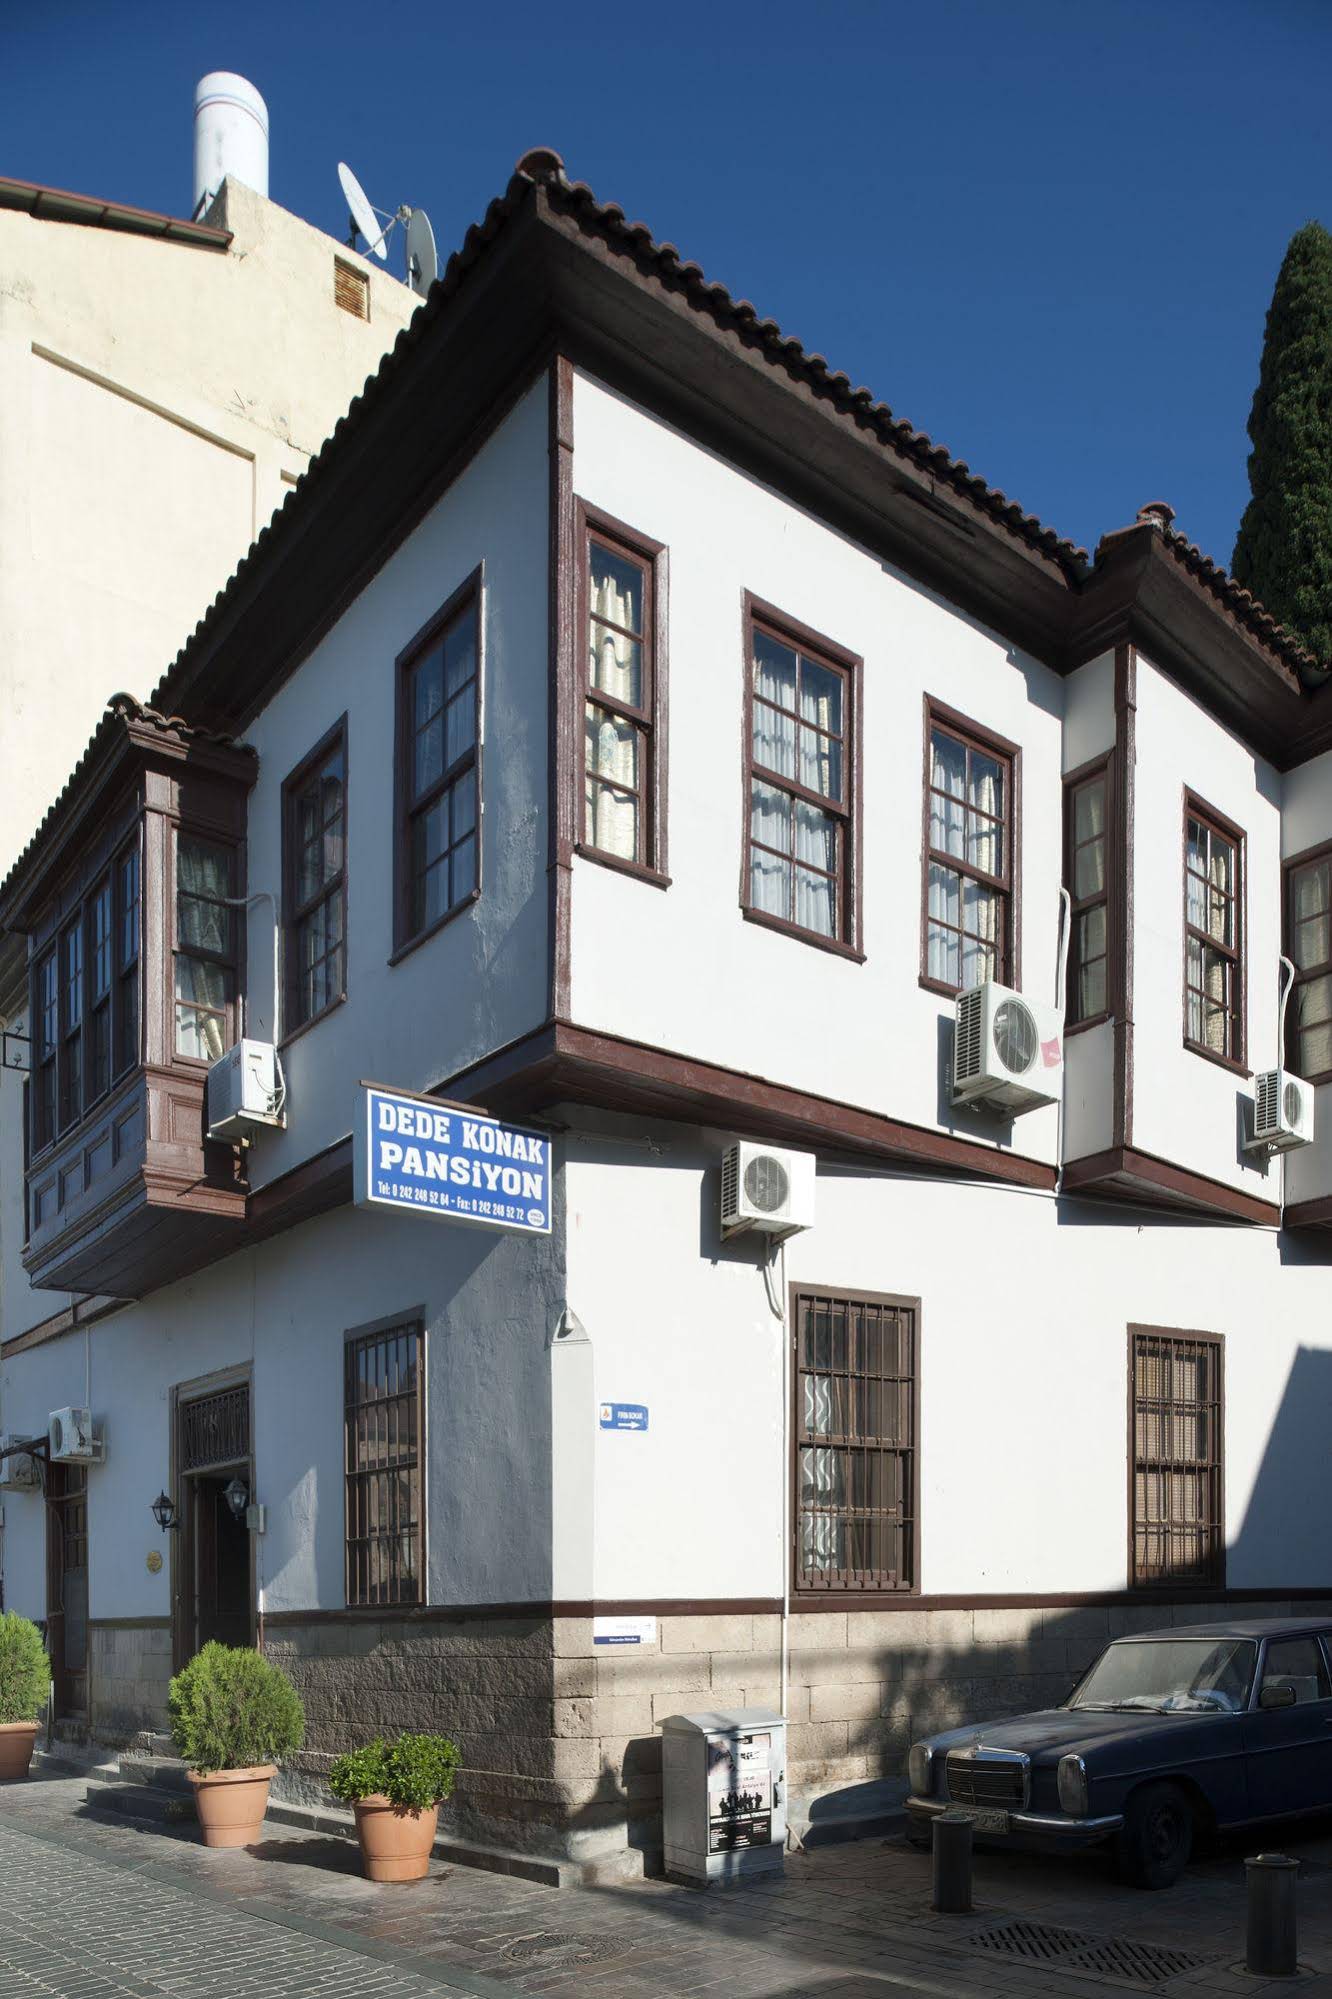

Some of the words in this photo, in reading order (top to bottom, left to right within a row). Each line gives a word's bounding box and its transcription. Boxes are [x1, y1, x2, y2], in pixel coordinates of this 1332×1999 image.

[378, 1102, 450, 1144] DEDE
[462, 1121, 544, 1164] KONAK
[378, 1181, 390, 1195] Tel:
[392, 1184, 398, 1197] 0
[400, 1185, 413, 1199] 242
[430, 1190, 439, 1205] 52
[457, 1196, 470, 1210] Fax:
[472, 1199, 477, 1212] 0
[479, 1200, 491, 1214] 242
[506, 1205, 515, 1219] 52
[516, 1207, 525, 1220] 72
